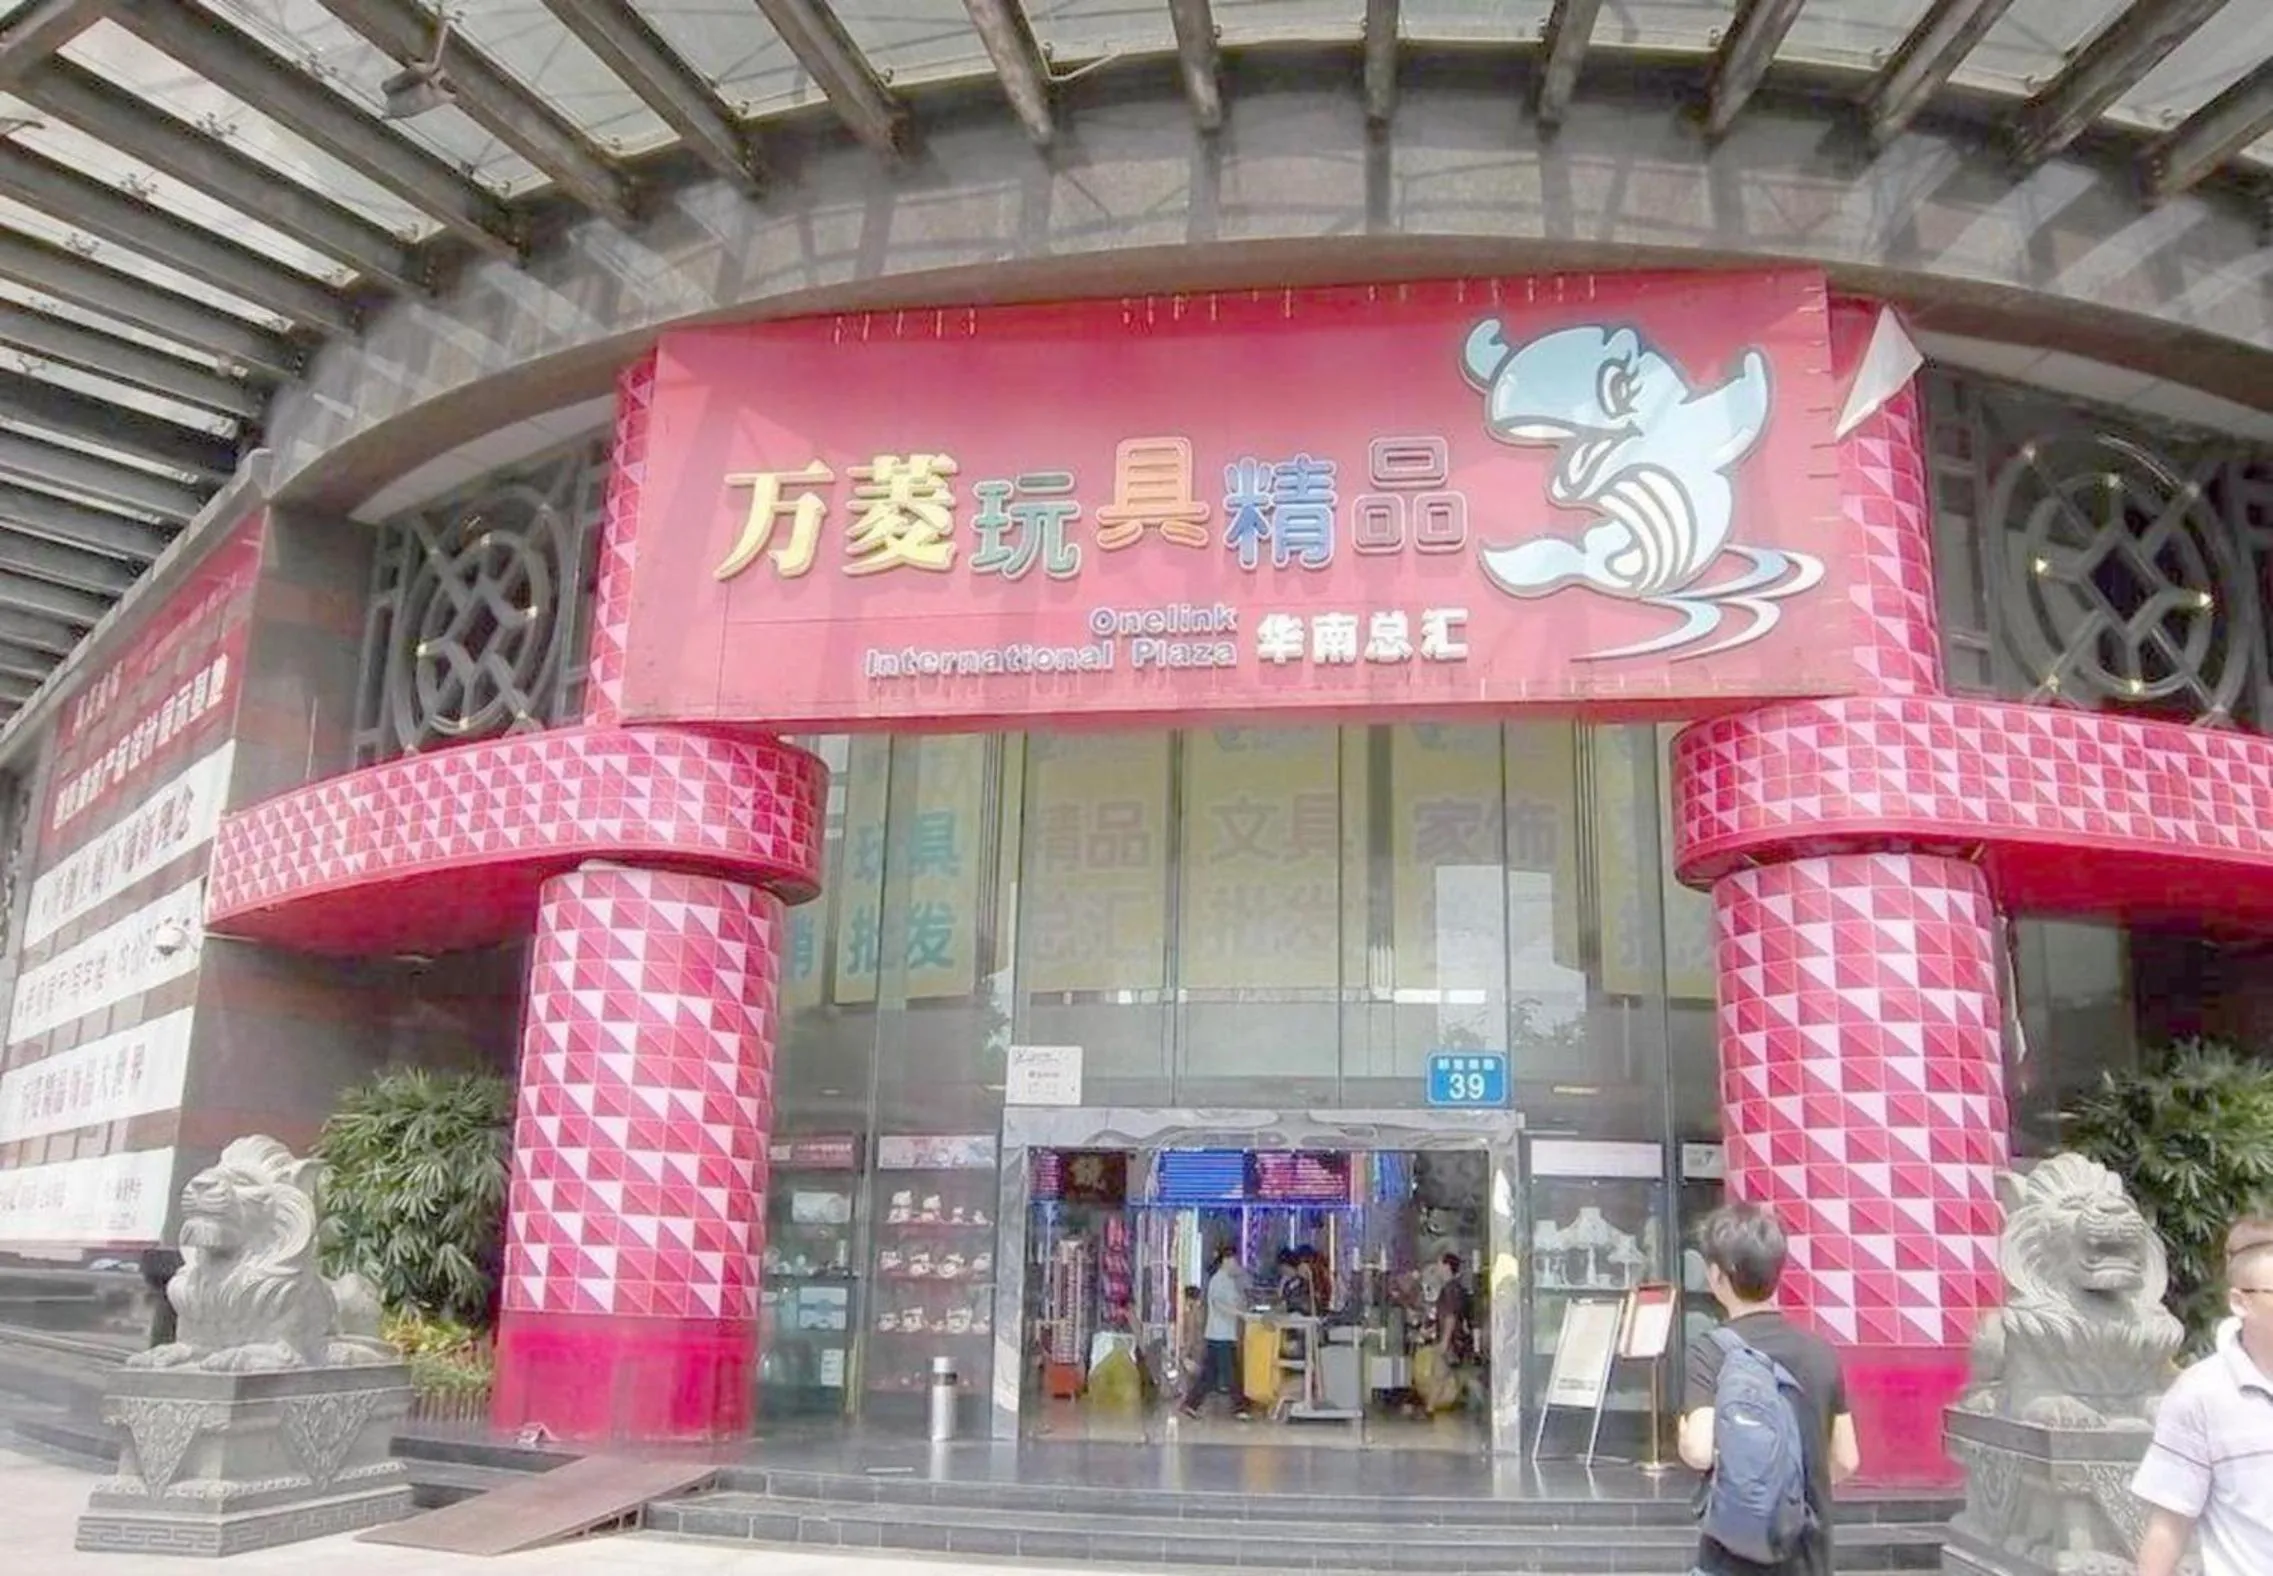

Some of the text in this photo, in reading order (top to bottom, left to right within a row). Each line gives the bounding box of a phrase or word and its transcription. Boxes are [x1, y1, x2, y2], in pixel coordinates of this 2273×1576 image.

[714, 436, 1467, 581] 万菱玩具精品
[1090, 603, 1238, 636] Onelink
[1257, 607, 1469, 666] 华南总汇
[864, 638, 1238, 677] International Plaza
[1449, 1073, 1485, 1100] 39
